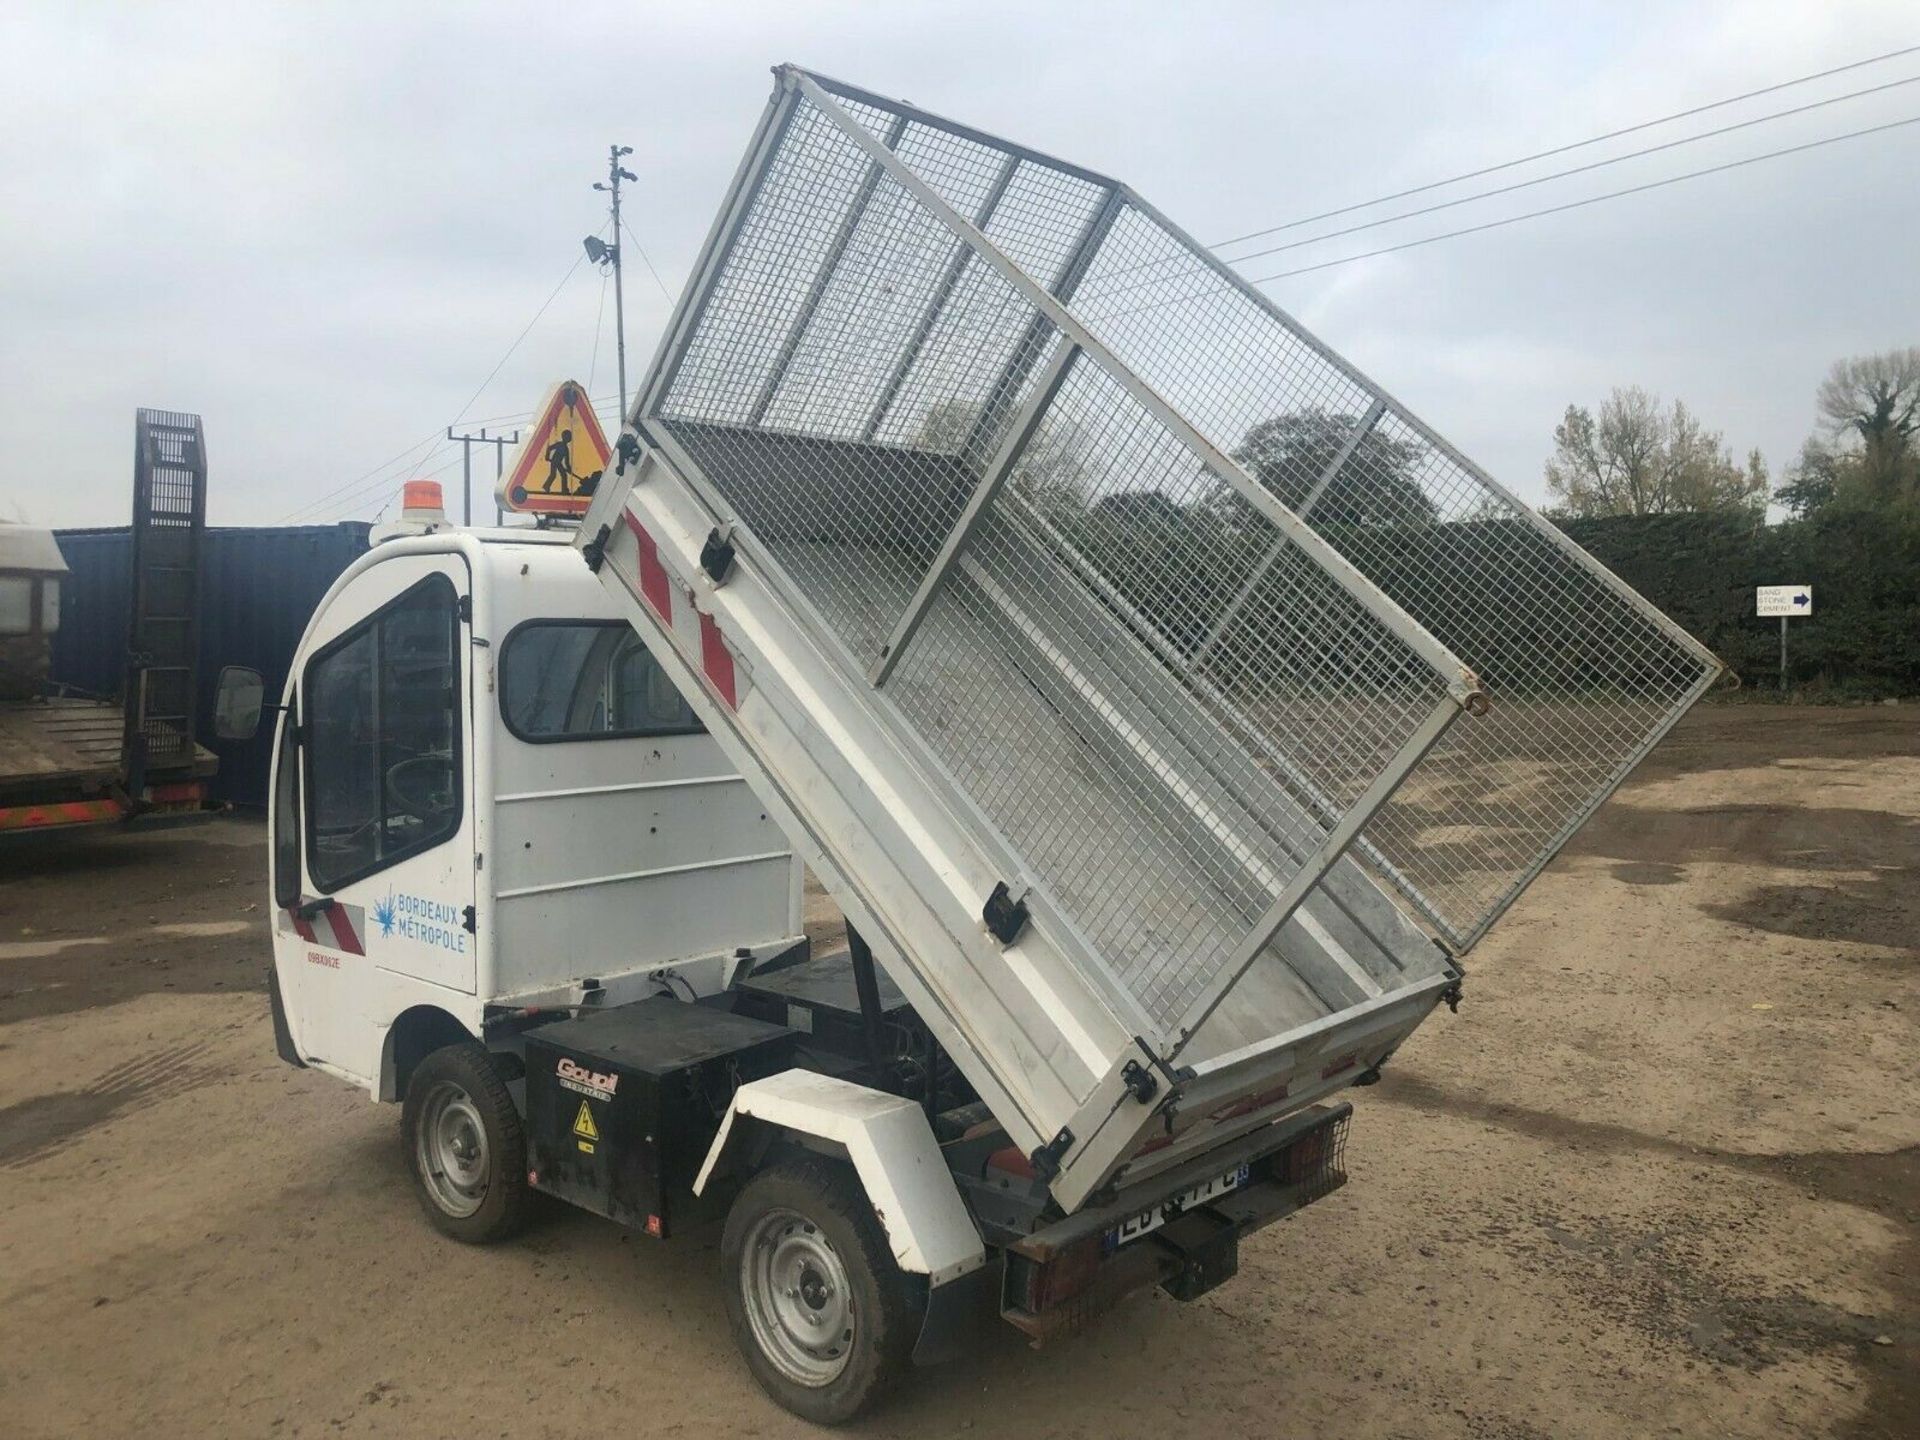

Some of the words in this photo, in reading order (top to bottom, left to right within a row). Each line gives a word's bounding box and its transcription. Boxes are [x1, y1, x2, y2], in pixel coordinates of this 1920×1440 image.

[398, 894, 458, 925] BORDEAUX
[398, 917, 465, 953] MÉTROPOLE
[557, 1058, 619, 1091] Goupil
